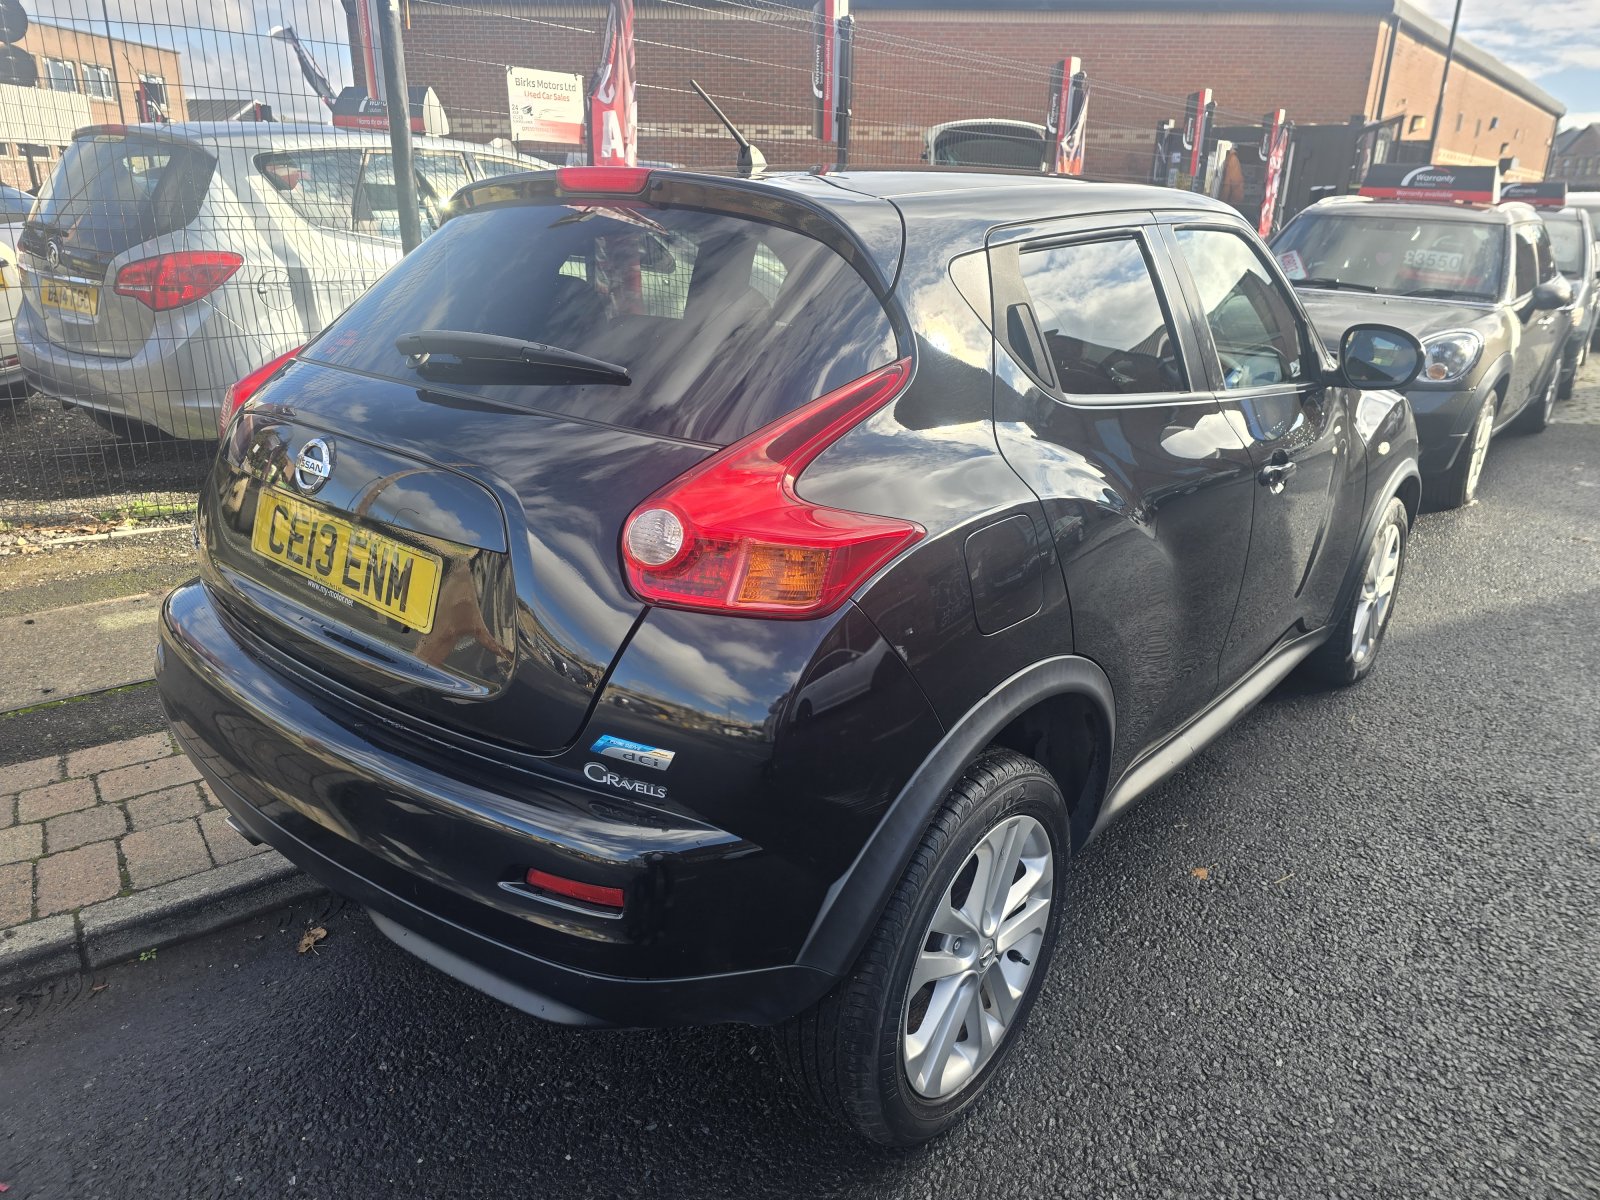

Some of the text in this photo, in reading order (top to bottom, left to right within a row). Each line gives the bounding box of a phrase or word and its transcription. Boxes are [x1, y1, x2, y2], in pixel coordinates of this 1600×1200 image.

[515, 77, 577, 92] Birks Motors Ltd
[524, 90, 570, 102] Used Car Sales
[1416, 174, 1456, 184] Warranty
[1396, 190, 1453, 199] Warranty available
[1403, 250, 1462, 271] £3550
[269, 504, 415, 613] CE13 ENM
[307, 579, 354, 607] www.my-motor.net
[622, 752, 659, 767] dCi
[583, 763, 667, 798] GRAVELLS
